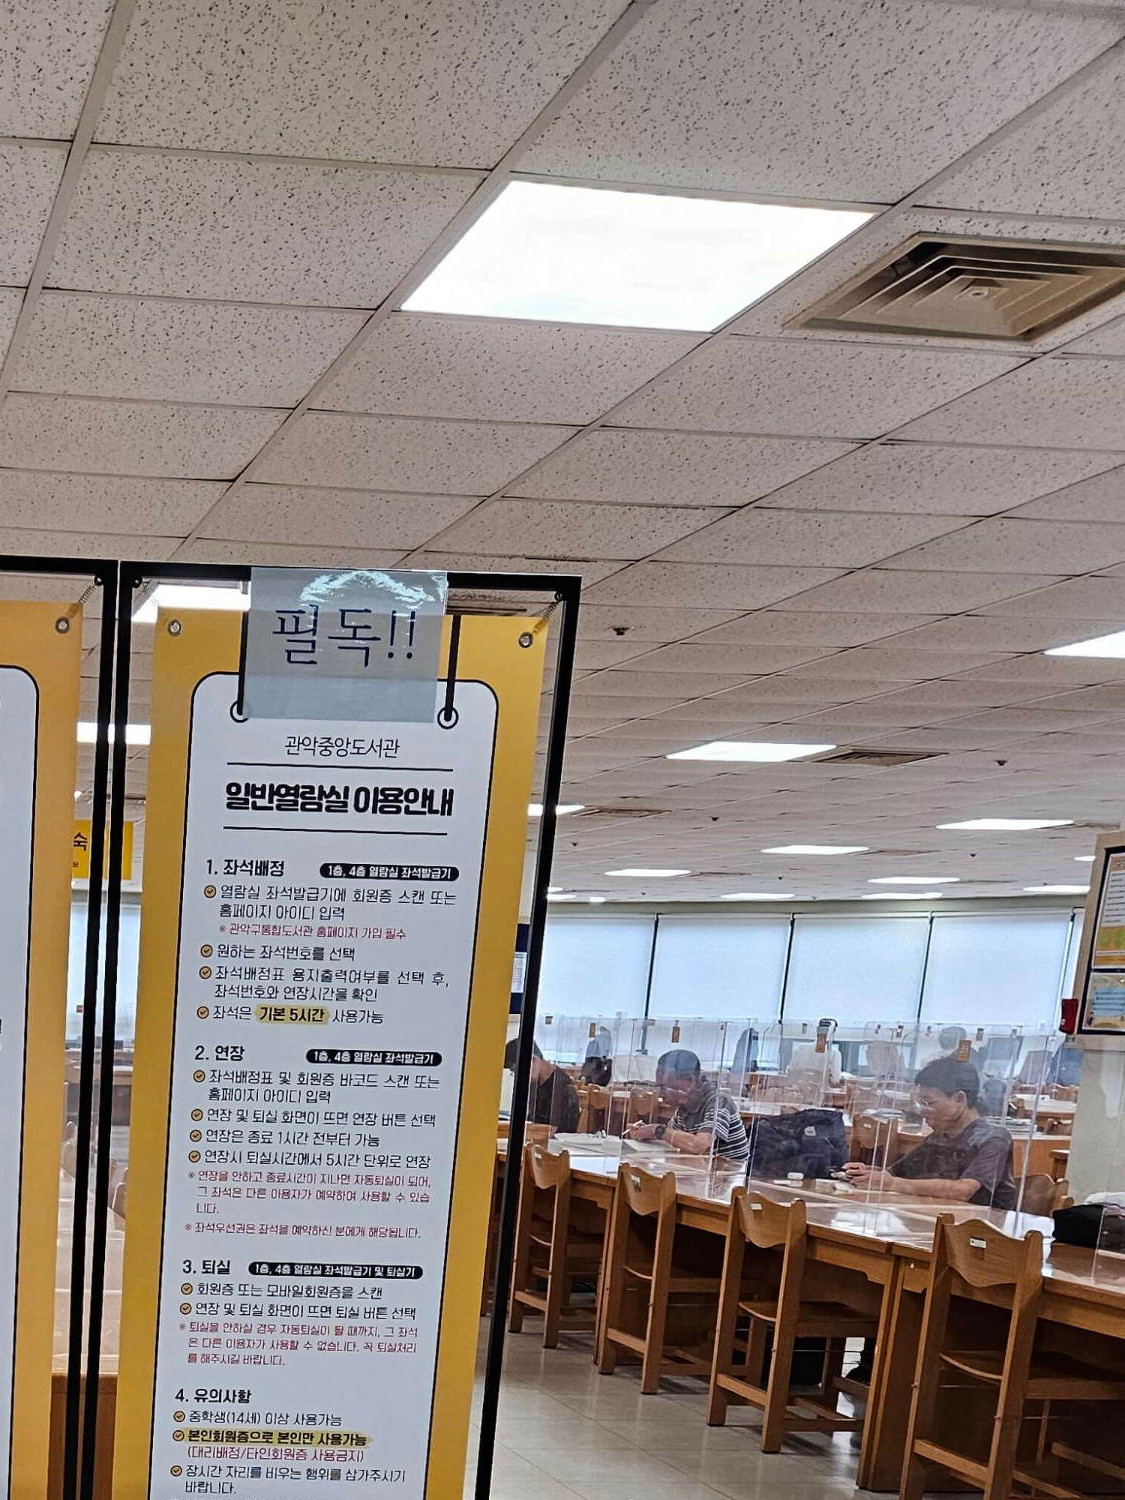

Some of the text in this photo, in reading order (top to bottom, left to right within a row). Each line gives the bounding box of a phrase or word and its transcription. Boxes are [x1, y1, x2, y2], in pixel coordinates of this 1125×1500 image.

[272, 604, 416, 668] 필독!!
[284, 735, 401, 759] 관악중앙도서관
[224, 782, 454, 816] 일반열람실 이용안내
[206, 859, 284, 877] 1. 좌석배정
[220, 884, 456, 905] 열람실 좌석발급기에 회원증 스캔 또는
[219, 903, 345, 921] 홈페이지 아이디 입력
[216, 943, 355, 961] 원하는 좌석번호를 선택
[215, 965, 449, 986] 좌석배정표 용지출력여부를 선택 후,
[214, 983, 377, 1002] 좌석번호와 연장시간을 확인
[212, 1005, 384, 1024] 좌석은 기본 5시간 사용가능
[194, 1045, 245, 1061] 2. 연장
[209, 1069, 440, 1089] 좌석배정표 및 회원증 바코드 스캔 또는
[182, 1259, 230, 1275] 3. 퇴실
[196, 1282, 382, 1300] 회원증 또는 모바일회원증을 스캔
[174, 1387, 252, 1404] 4. 유의사항
[188, 1410, 342, 1427] 중학생(14세) 이상 사용가능
[187, 1429, 367, 1446] 본인회원증으로 본인만 사용가능
[187, 1445, 364, 1463] (대리배정/타인회원증 사용금지)
